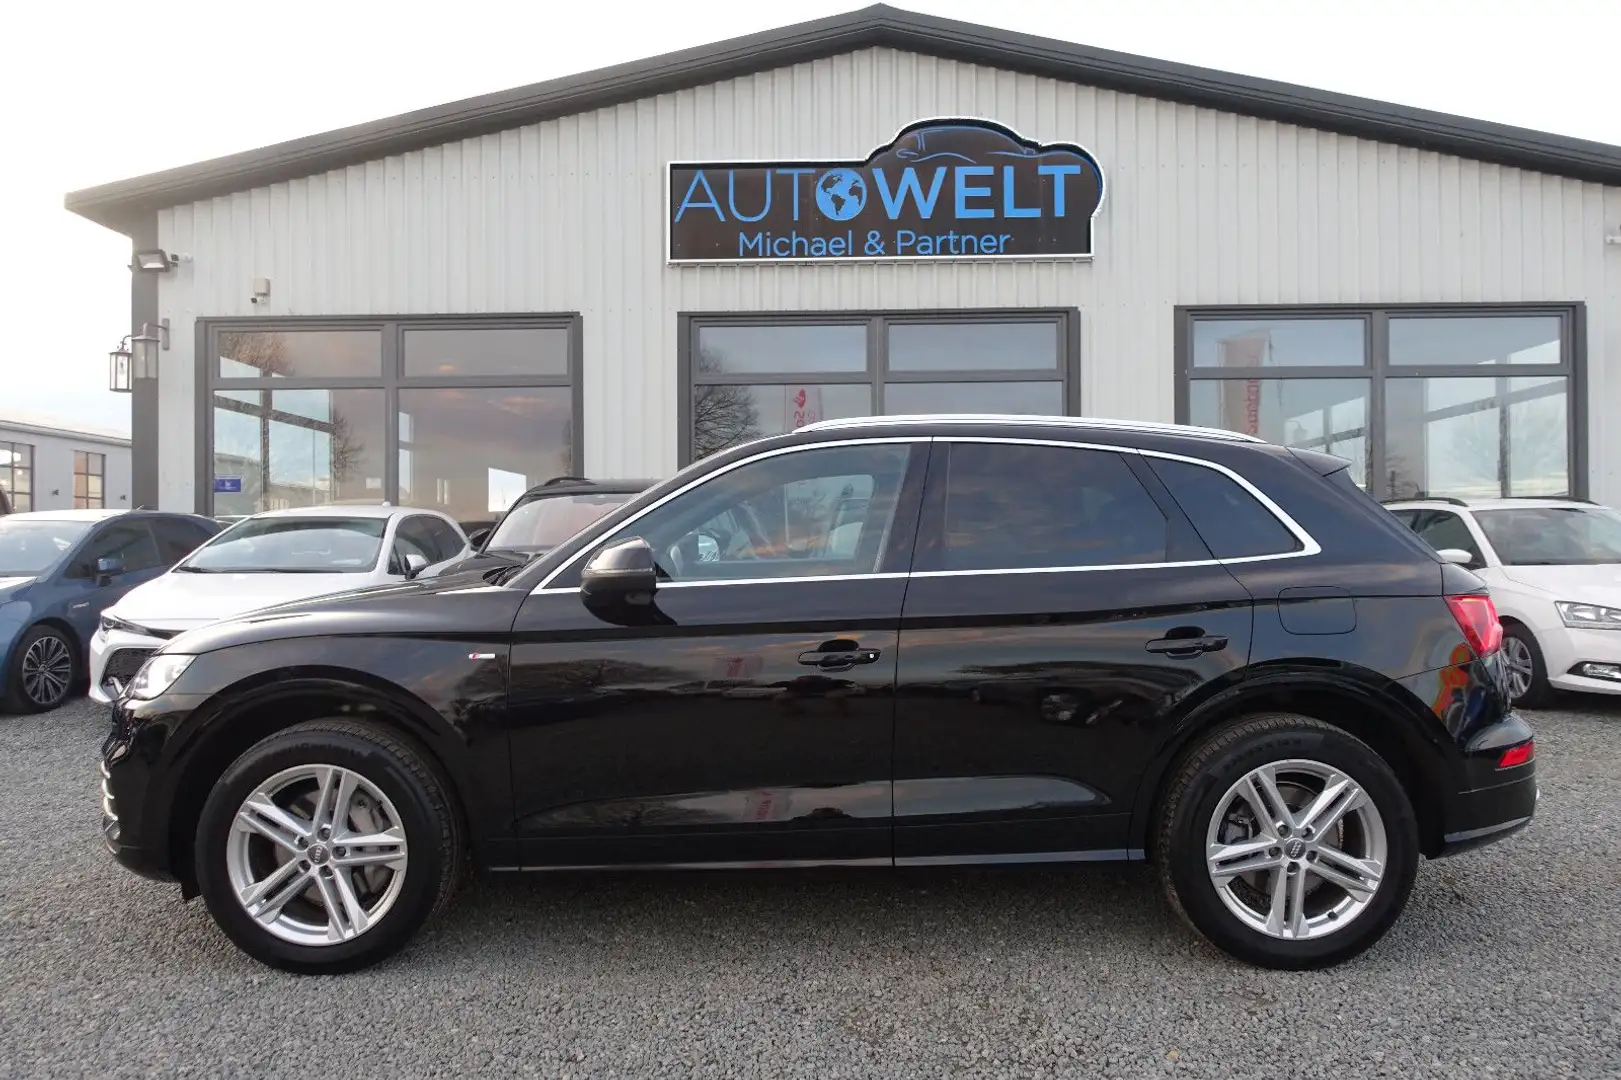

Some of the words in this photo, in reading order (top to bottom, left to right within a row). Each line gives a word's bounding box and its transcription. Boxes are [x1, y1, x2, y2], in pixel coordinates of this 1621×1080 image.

[738, 230, 852, 257] Michael
[864, 231, 885, 256] &
[896, 230, 1012, 255] Partner
